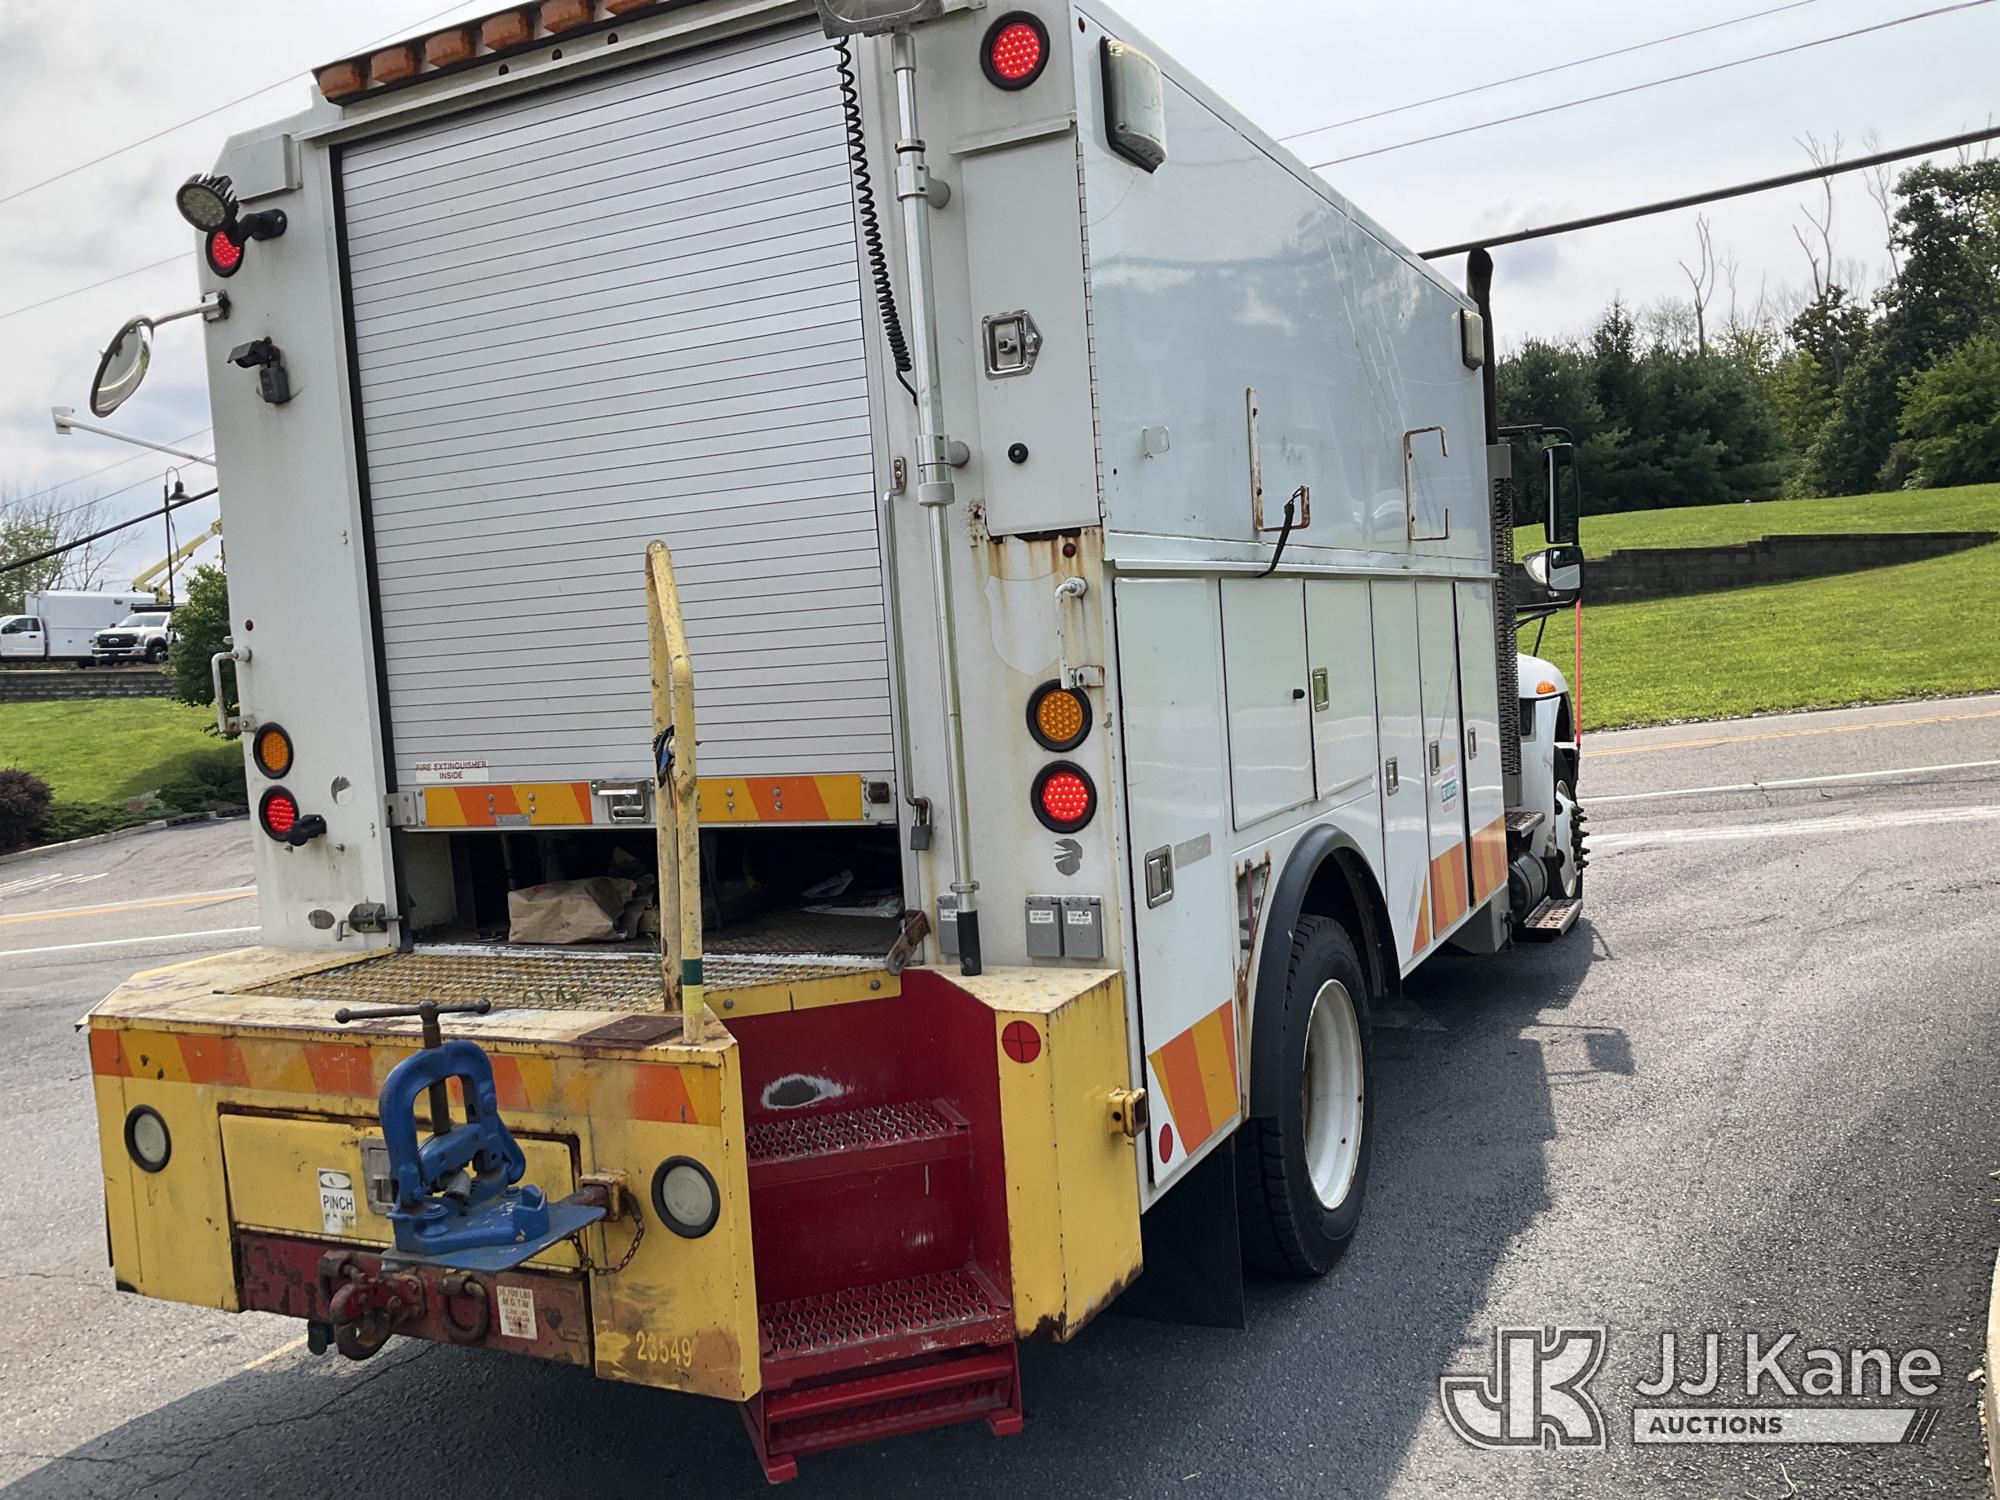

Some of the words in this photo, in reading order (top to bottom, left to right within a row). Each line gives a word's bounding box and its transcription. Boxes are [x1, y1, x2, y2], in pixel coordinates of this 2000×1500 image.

[416, 763, 432, 771] FIRE
[433, 761, 487, 770] EXTINGUISHER
[439, 771, 463, 779] INSIDE
[323, 1195, 353, 1211] PINCH
